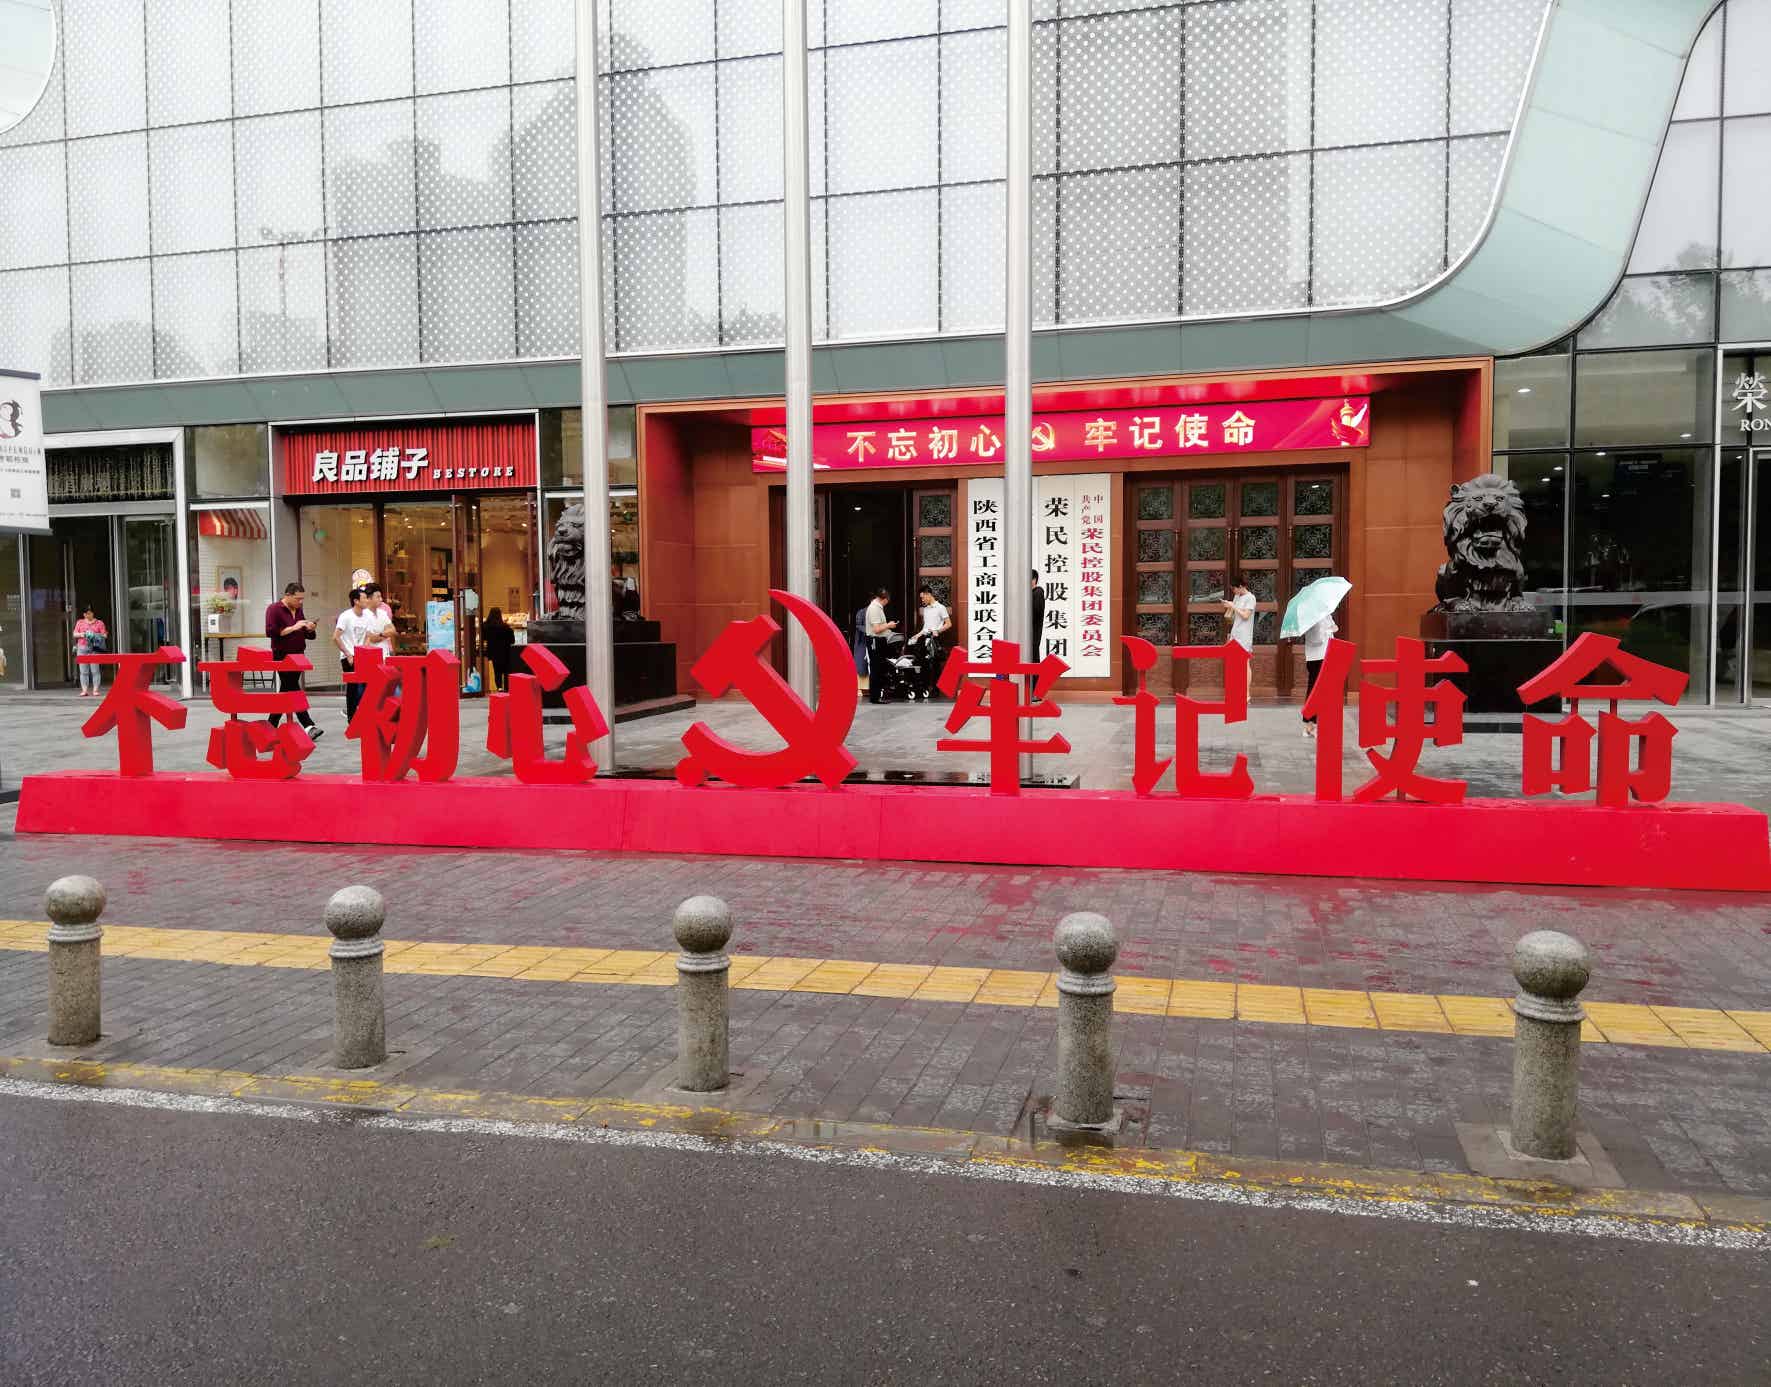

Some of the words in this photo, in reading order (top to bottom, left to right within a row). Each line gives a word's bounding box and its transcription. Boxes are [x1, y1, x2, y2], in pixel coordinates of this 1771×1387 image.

[312, 447, 429, 482] 良品铺子
[432, 466, 514, 480] BESTORE
[846, 424, 1001, 463] 不忘初心
[1084, 410, 1257, 453] 牢记使命
[973, 499, 998, 659] 陕西省工商业联合会
[1044, 497, 1069, 657] 荣民控股集团
[1081, 527, 1104, 658] 荣民控股集团委员会
[76, 643, 610, 785] 不忘初心
[936, 631, 1689, 807] 牢记使命
